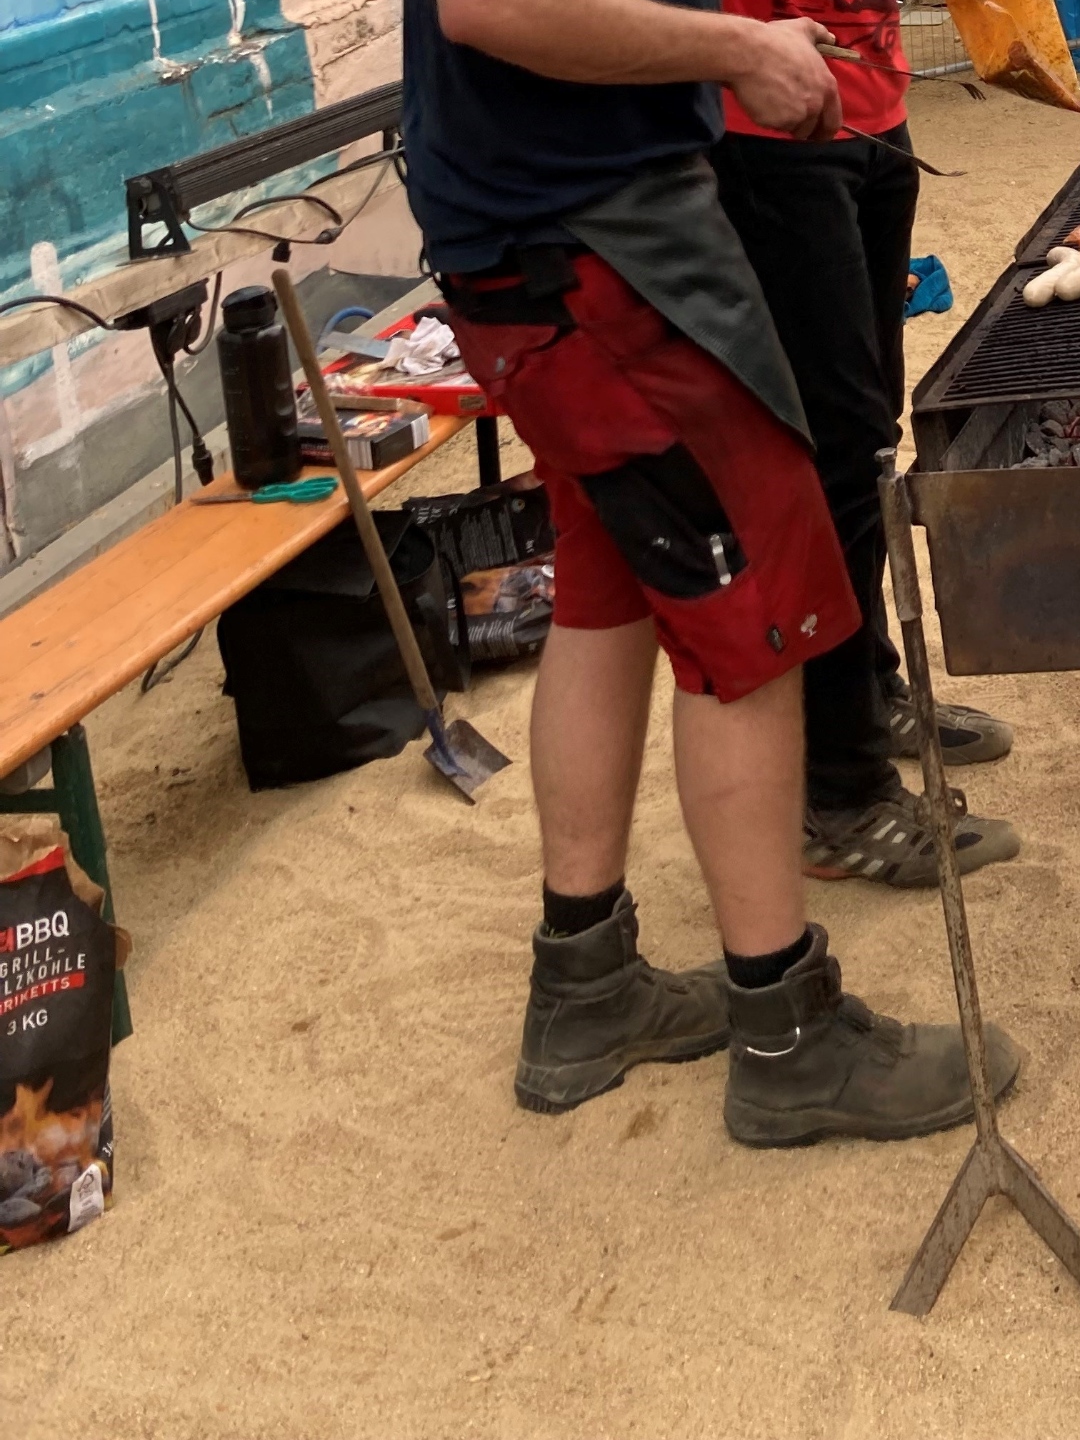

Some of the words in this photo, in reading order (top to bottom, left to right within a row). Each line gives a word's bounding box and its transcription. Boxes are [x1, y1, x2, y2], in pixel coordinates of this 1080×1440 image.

[16, 909, 70, 951] BBQ
[6, 1019, 17, 1036] 3
[22, 1008, 48, 1032] KG
